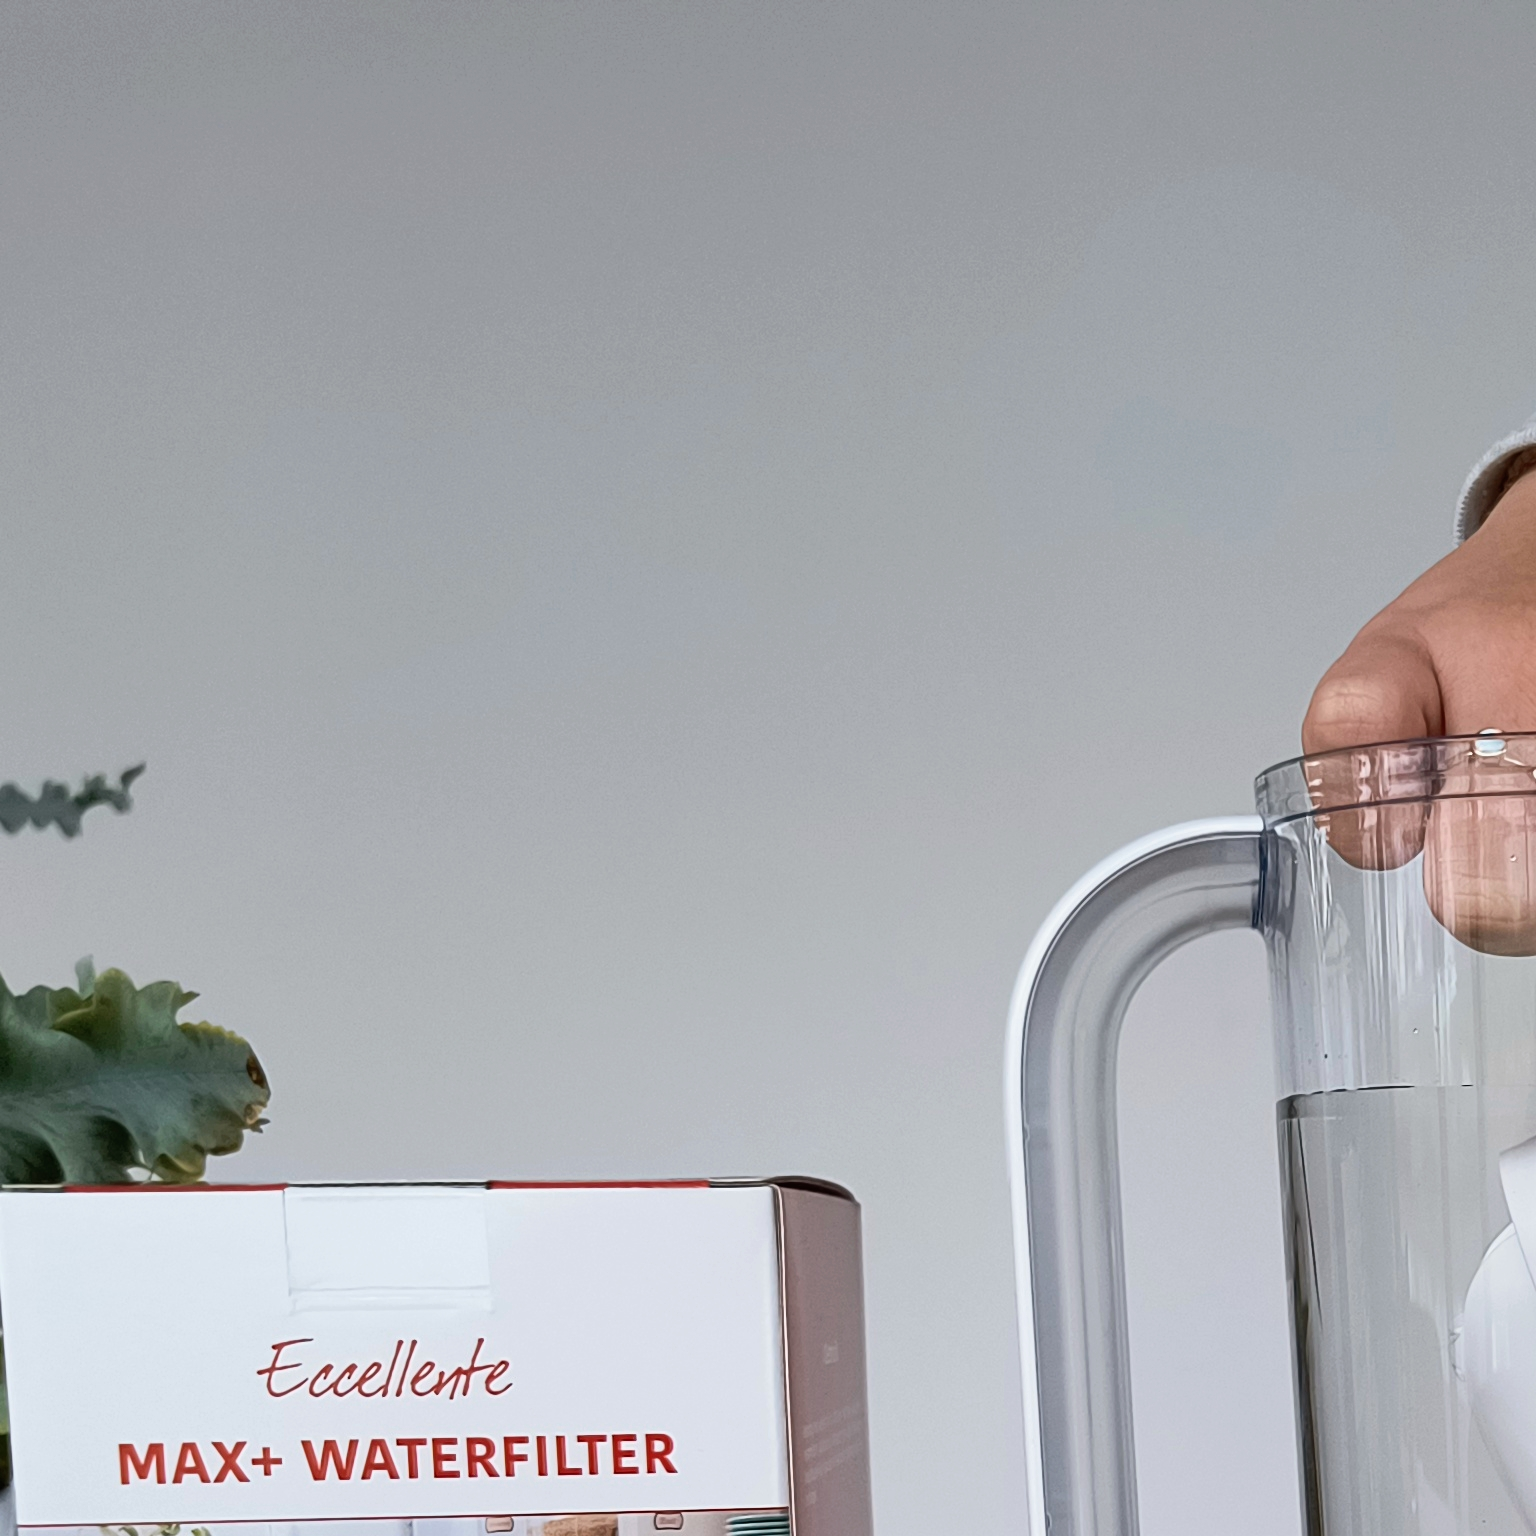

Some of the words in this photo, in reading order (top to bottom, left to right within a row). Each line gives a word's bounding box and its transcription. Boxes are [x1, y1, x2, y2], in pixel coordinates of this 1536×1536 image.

[256, 1337, 513, 1400] Eccellente
[118, 1441, 283, 1485] MAX+
[301, 1433, 678, 1482] WATERFILTER
